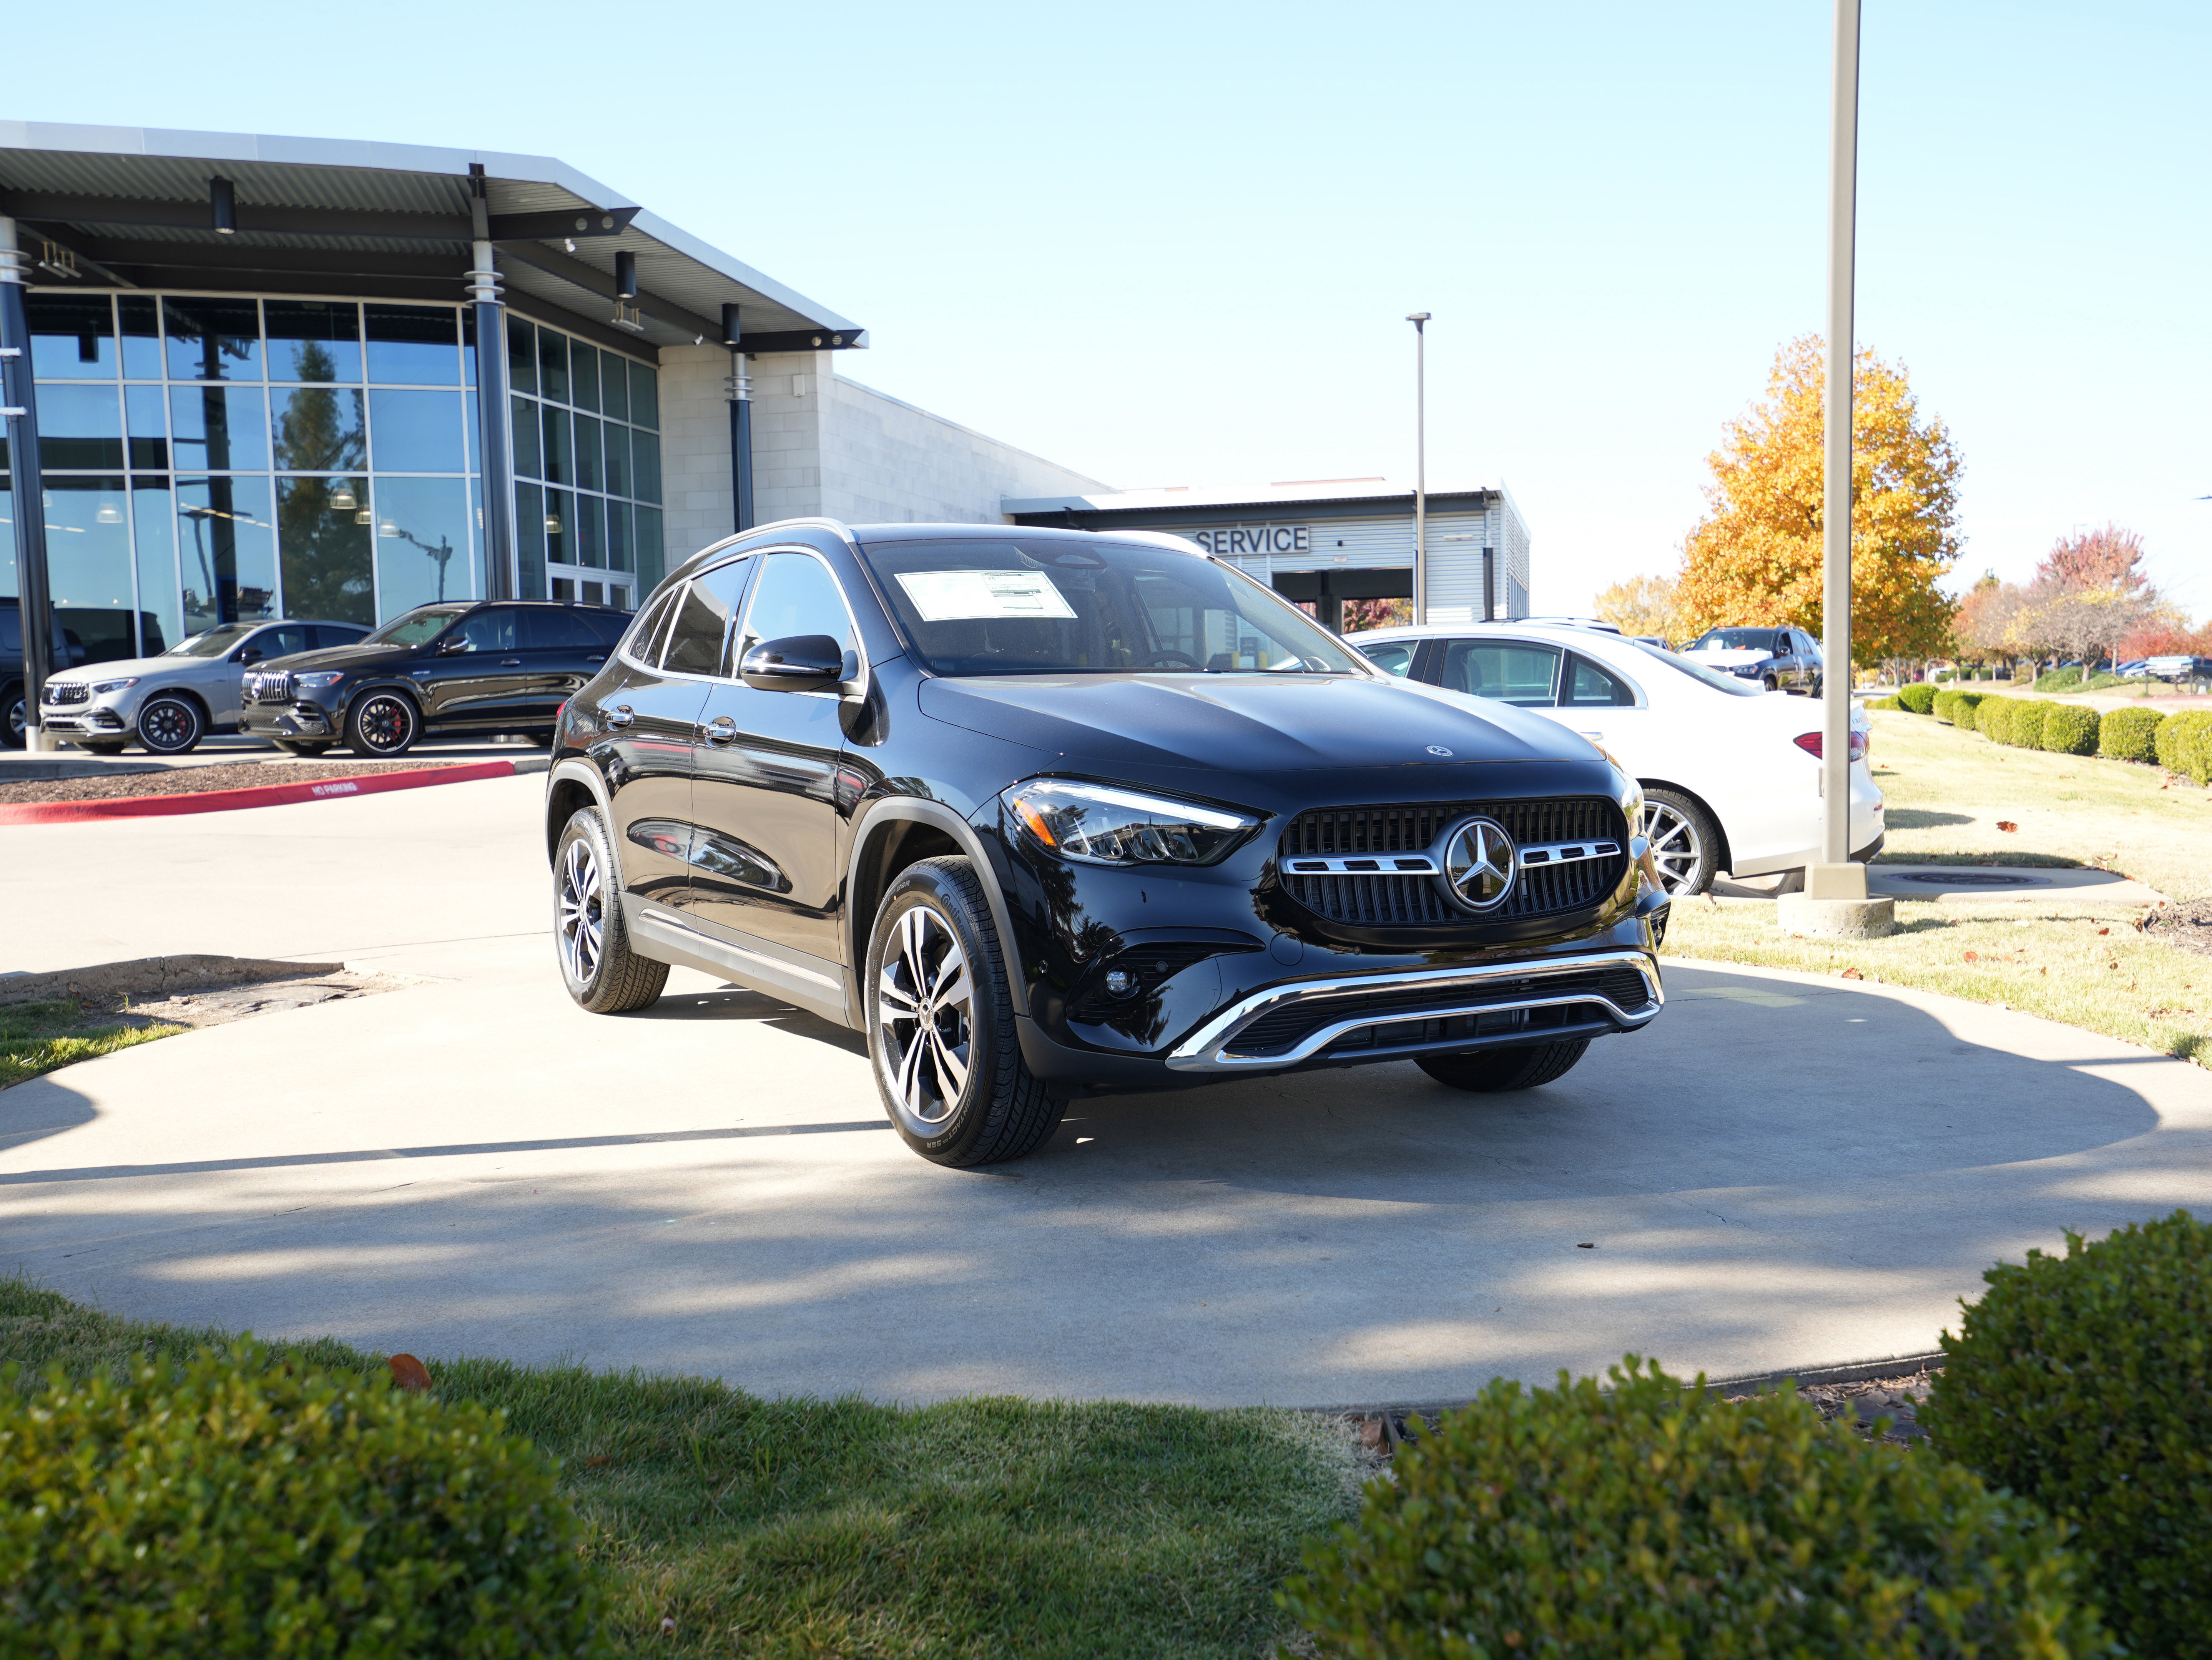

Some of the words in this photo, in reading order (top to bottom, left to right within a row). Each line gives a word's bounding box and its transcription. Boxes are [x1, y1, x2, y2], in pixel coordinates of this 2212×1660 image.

[1196, 528, 1307, 554] SERVICE
[312, 785, 325, 796] NO
[324, 782, 357, 794] PARKING
[941, 893, 976, 960] Continental
[926, 1140, 942, 1149] SSR
